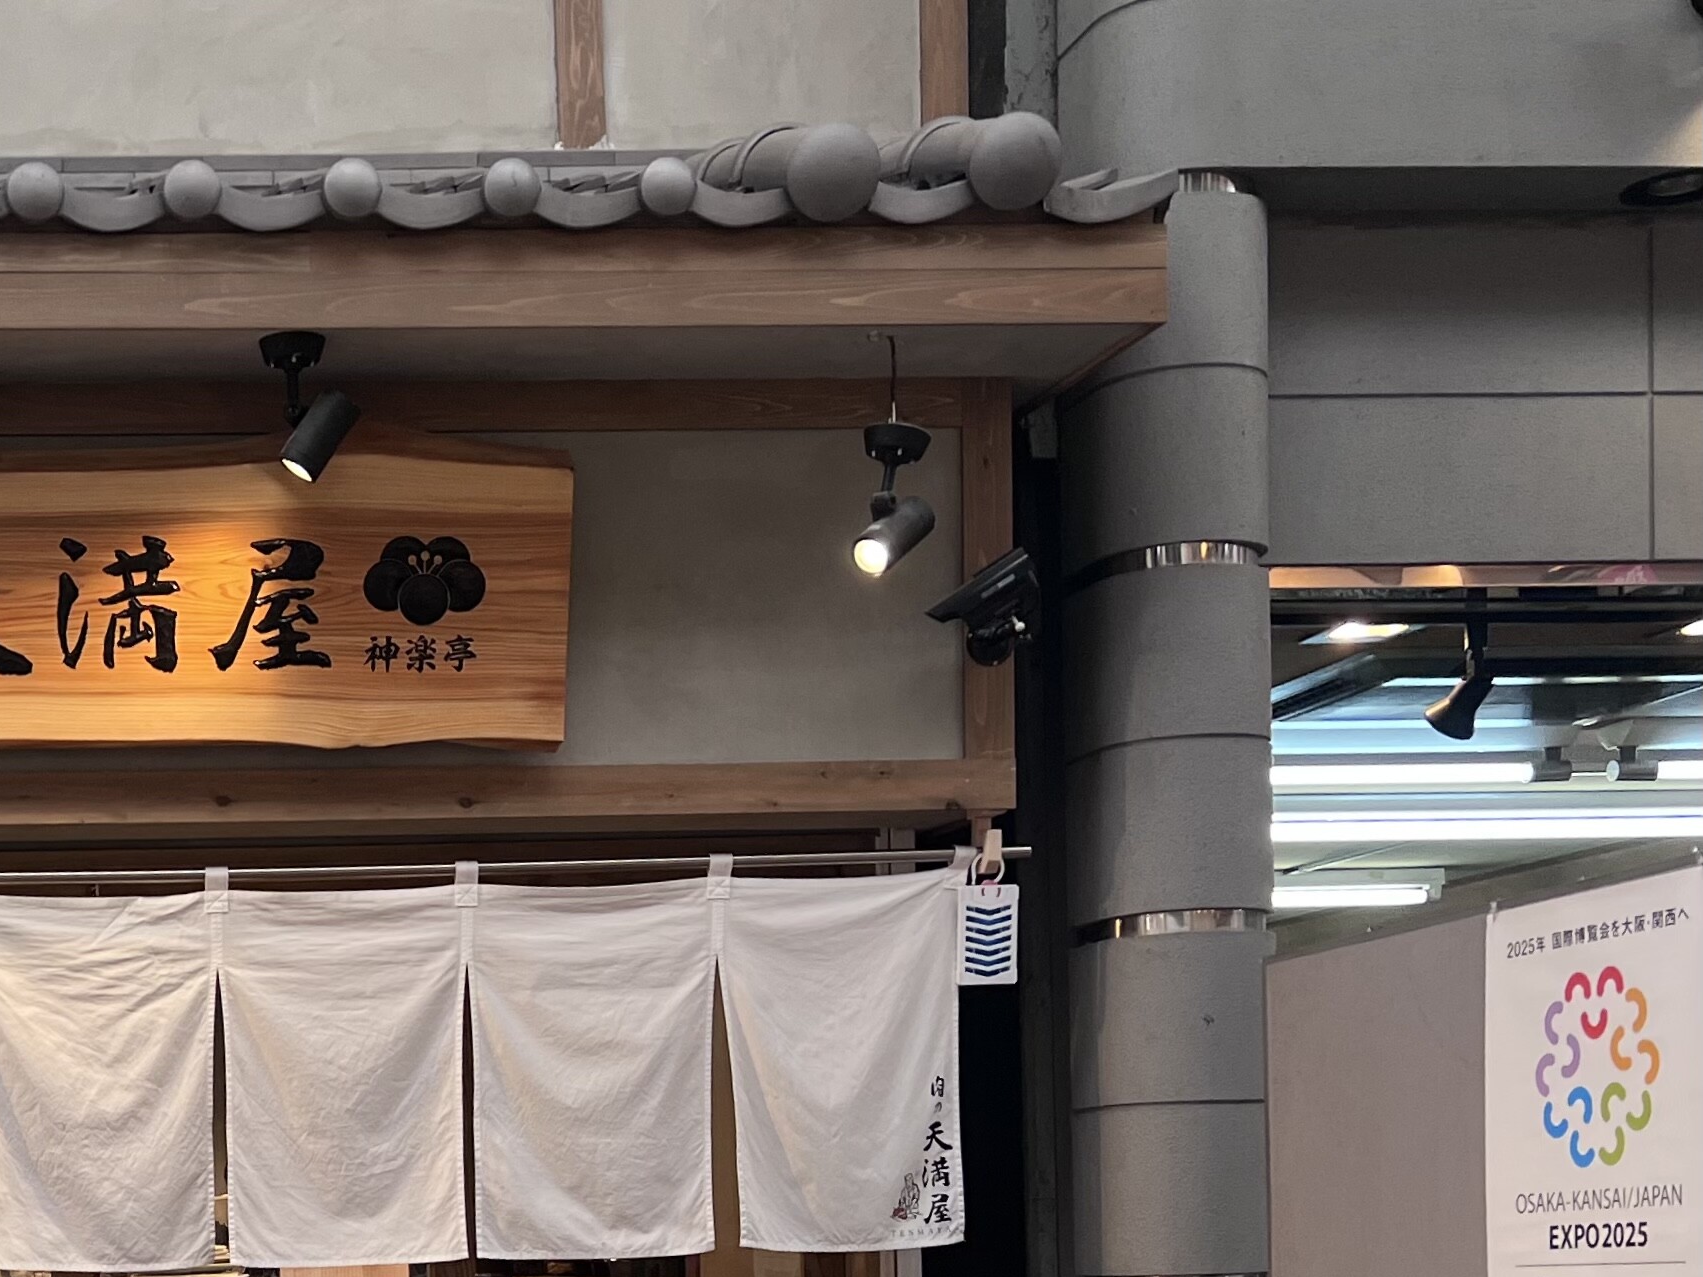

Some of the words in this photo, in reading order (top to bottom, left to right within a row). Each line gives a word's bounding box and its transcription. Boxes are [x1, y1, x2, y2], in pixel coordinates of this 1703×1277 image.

[364, 632, 479, 674] 神楽亭
[1507, 935, 1546, 959] 2025年
[922, 1075, 953, 1224] 肉の天満屋
[1515, 1184, 1684, 1215] OSAKA-KANSAI/JAPAN
